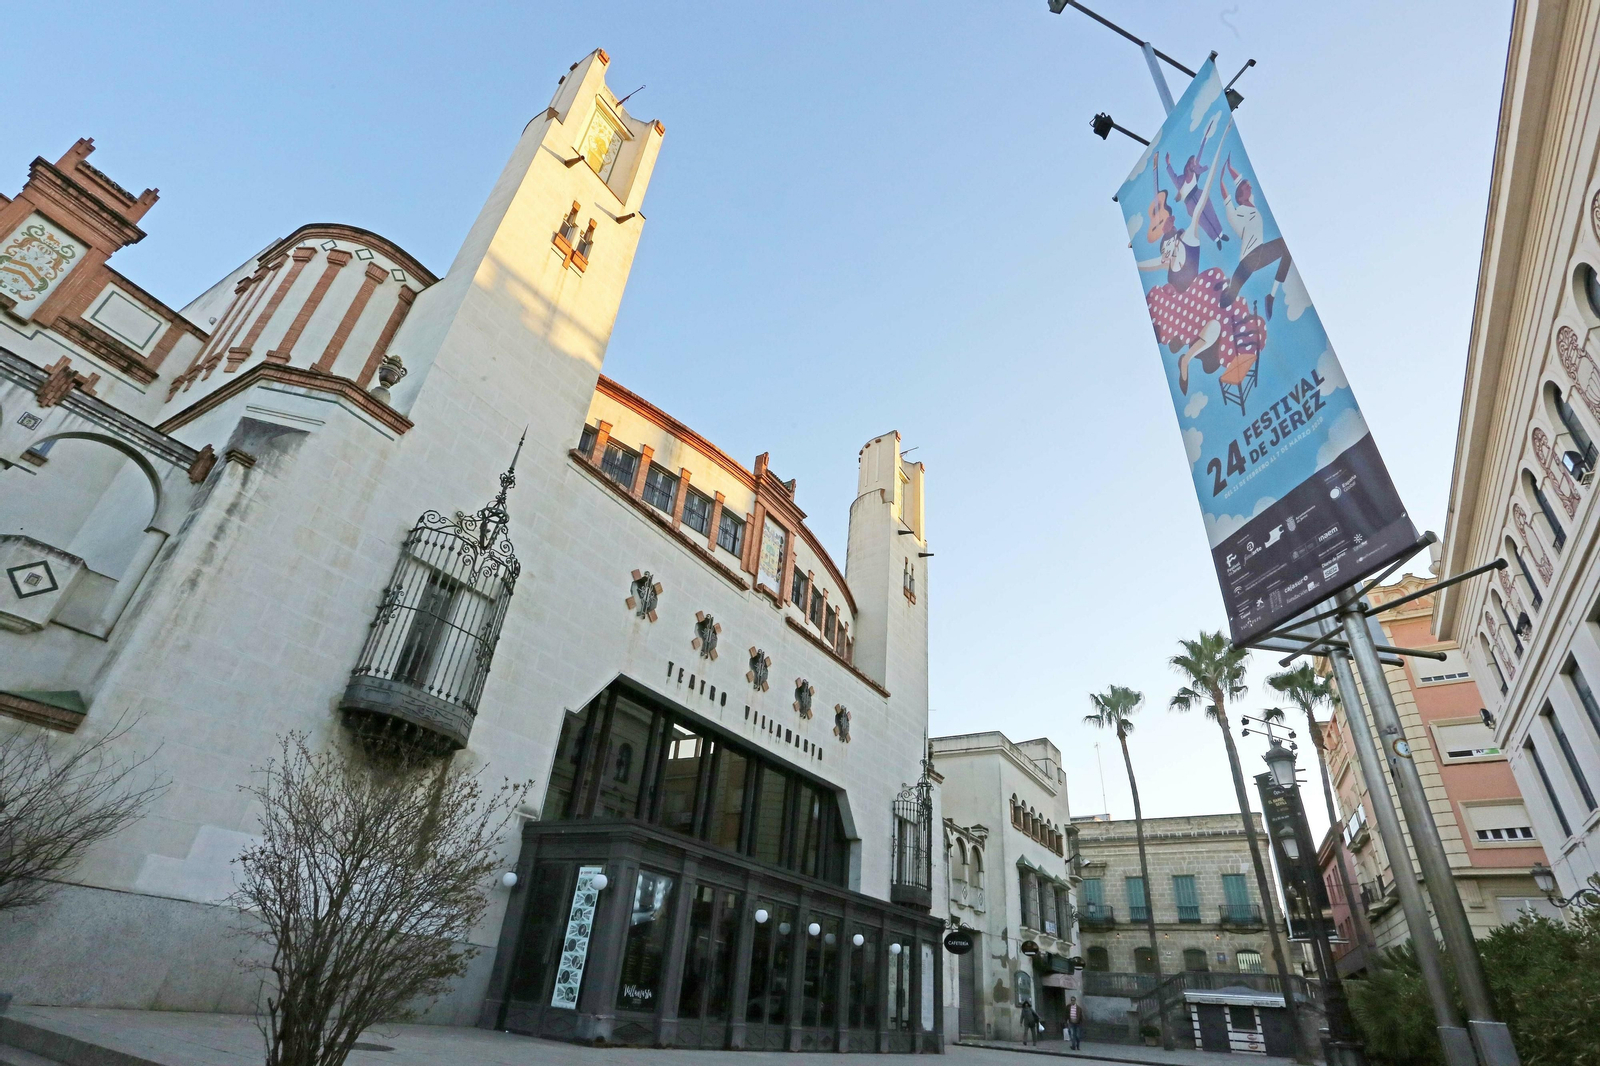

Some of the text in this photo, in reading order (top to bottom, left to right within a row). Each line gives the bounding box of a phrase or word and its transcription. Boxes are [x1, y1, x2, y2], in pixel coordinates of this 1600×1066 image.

[1243, 369, 1325, 446] FESTIVAL
[1249, 389, 1326, 464] DE JEREZ
[1207, 439, 1246, 497] 24
[1246, 461, 1270, 482] FEBRERO
[1269, 455, 1277, 463] AL
[1280, 445, 1288, 454] DE
[1289, 430, 1311, 447] MARZO
[667, 661, 823, 761] TEATRO VILLAMARTA
